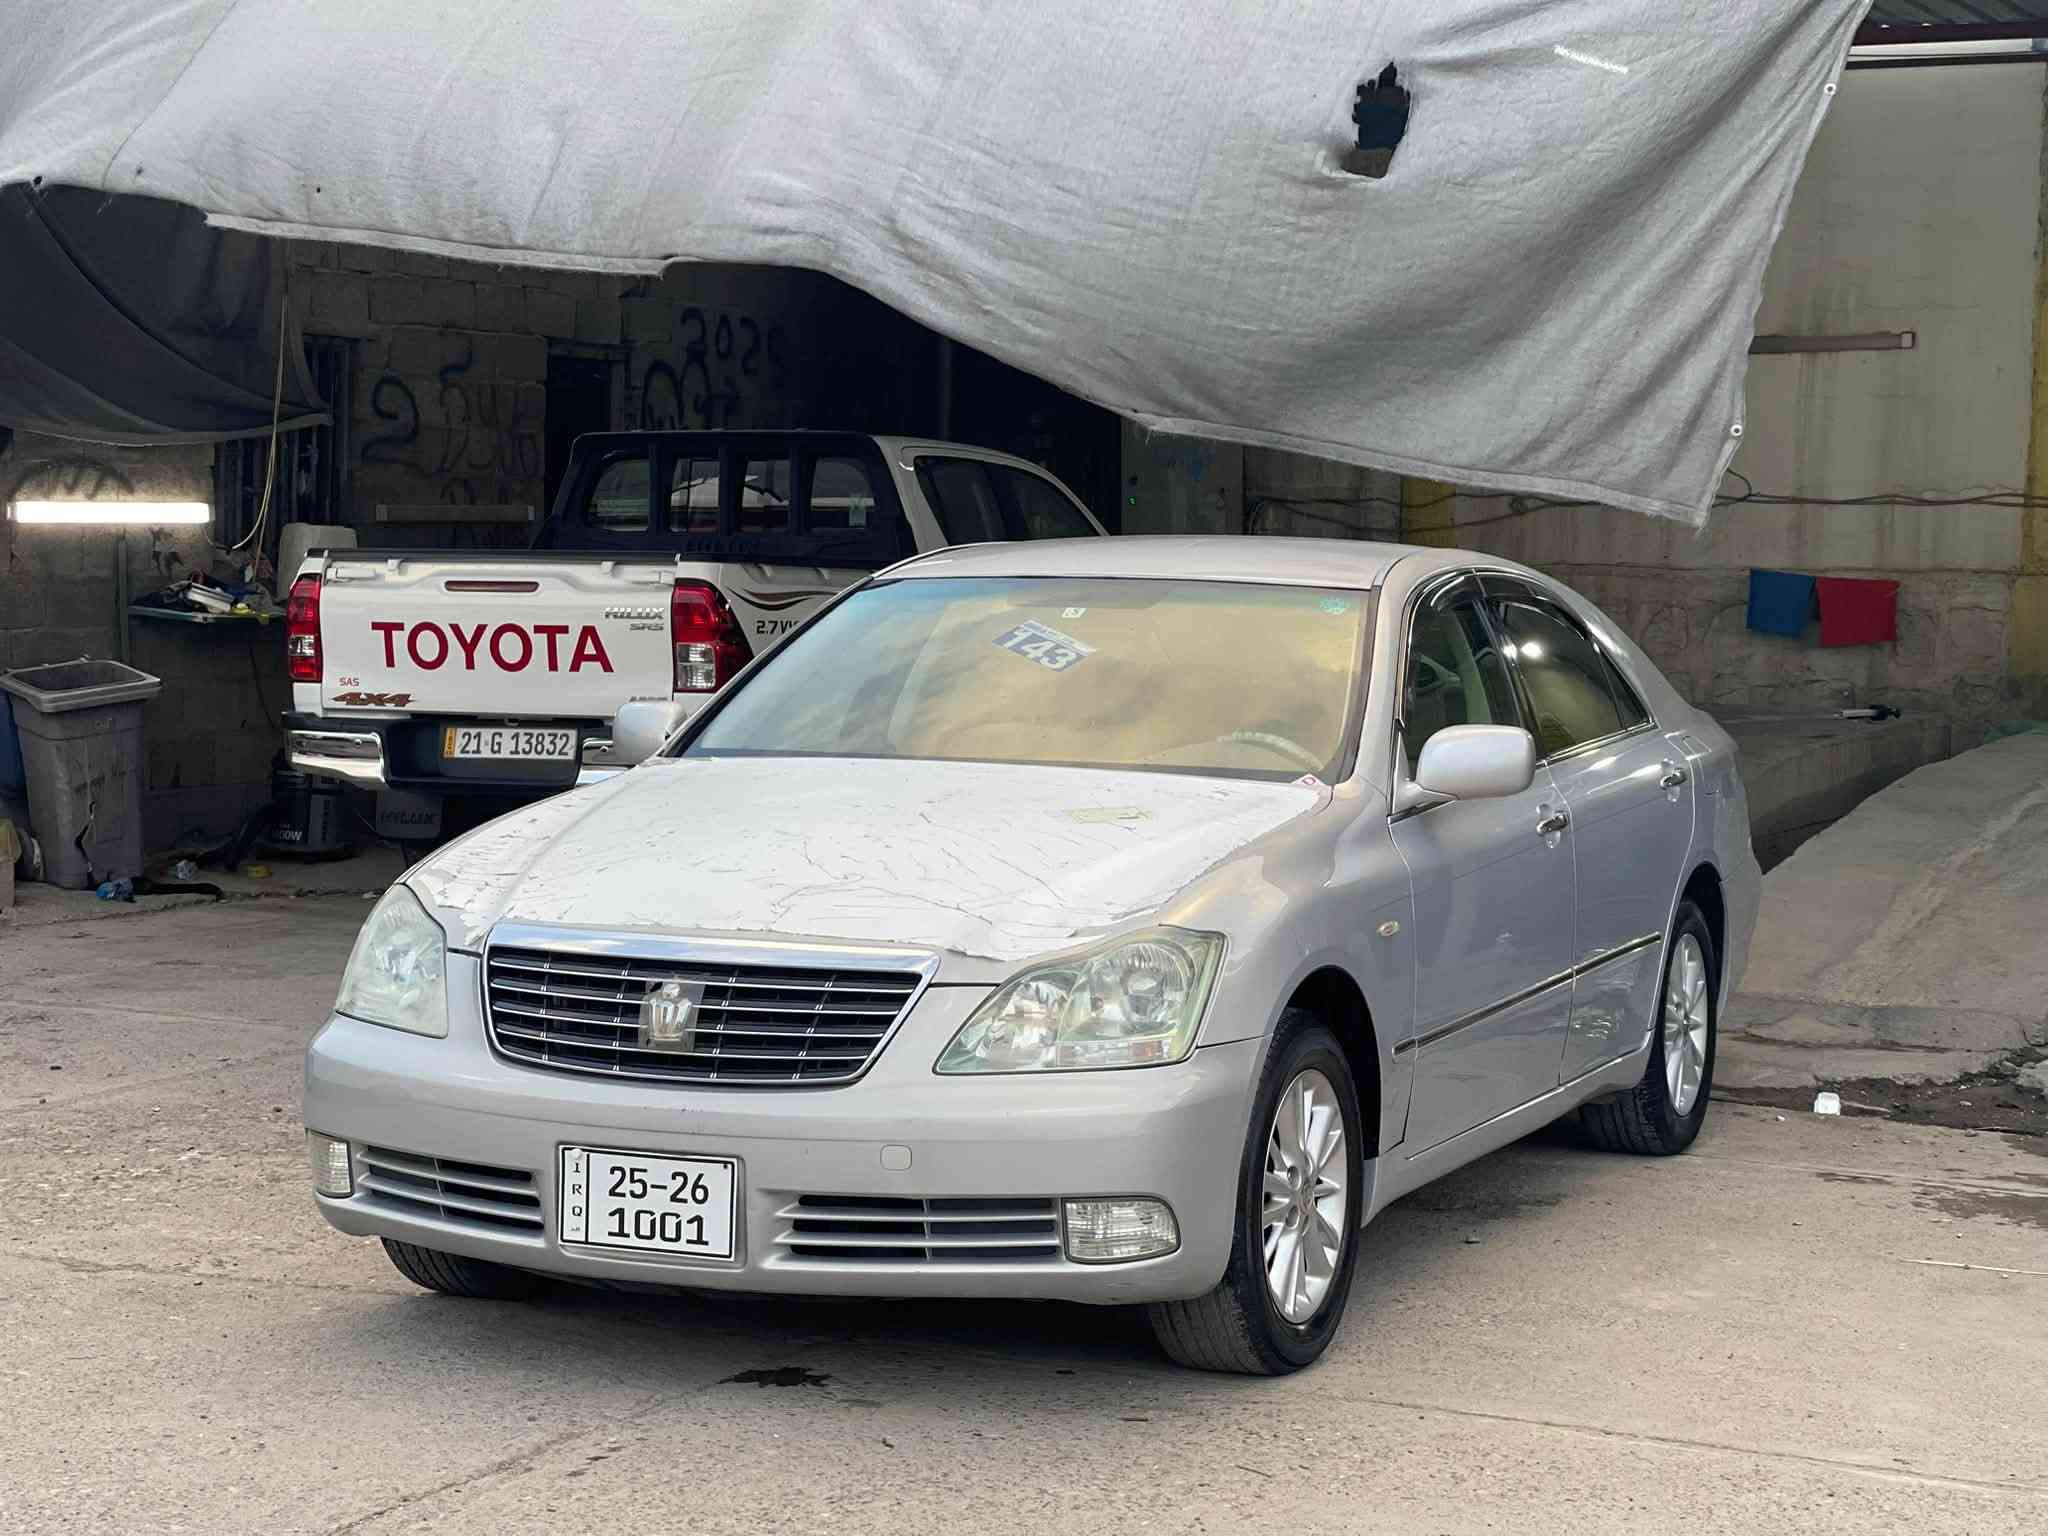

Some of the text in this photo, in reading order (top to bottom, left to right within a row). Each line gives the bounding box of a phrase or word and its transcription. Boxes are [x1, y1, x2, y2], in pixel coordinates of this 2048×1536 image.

[371, 620, 615, 673] TOYOTA
[1003, 630, 1077, 669] 143
[460, 731, 482, 754] 21
[490, 731, 503, 754] G
[509, 732, 570, 756] 13832
[608, 1165, 709, 1205] 25-26
[607, 1207, 709, 1246] 1001
